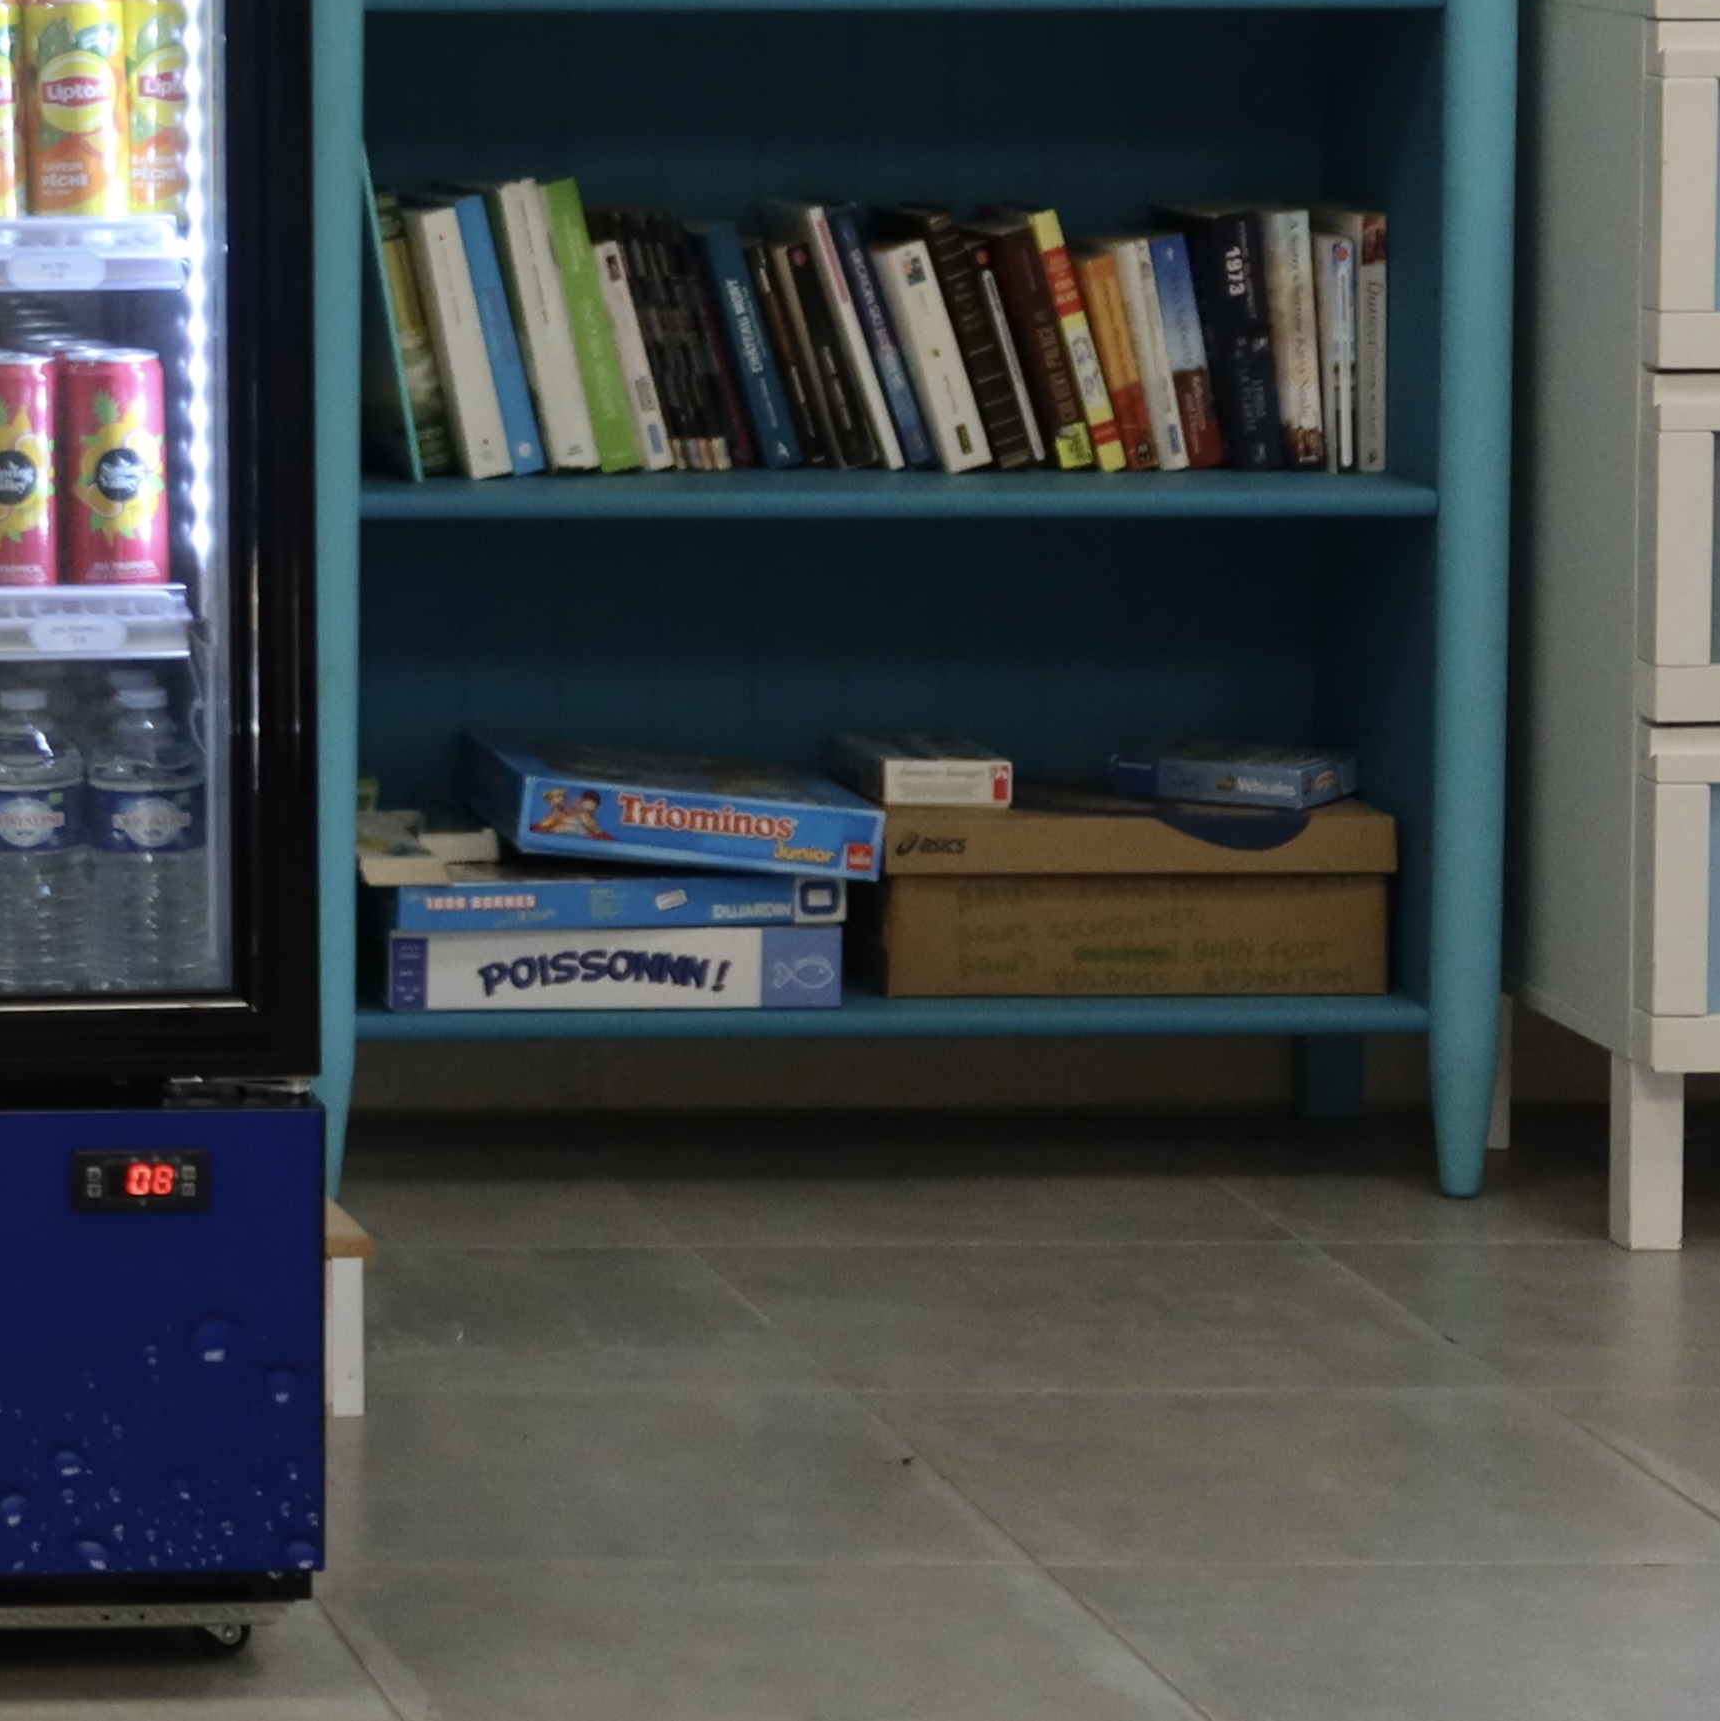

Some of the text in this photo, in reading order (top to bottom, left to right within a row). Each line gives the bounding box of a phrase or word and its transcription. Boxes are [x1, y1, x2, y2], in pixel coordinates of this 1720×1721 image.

[1225, 245, 1246, 297] 1973
[618, 792, 799, 840] Triominos
[772, 841, 835, 864] Junior
[126, 1161, 175, 1196] 08
